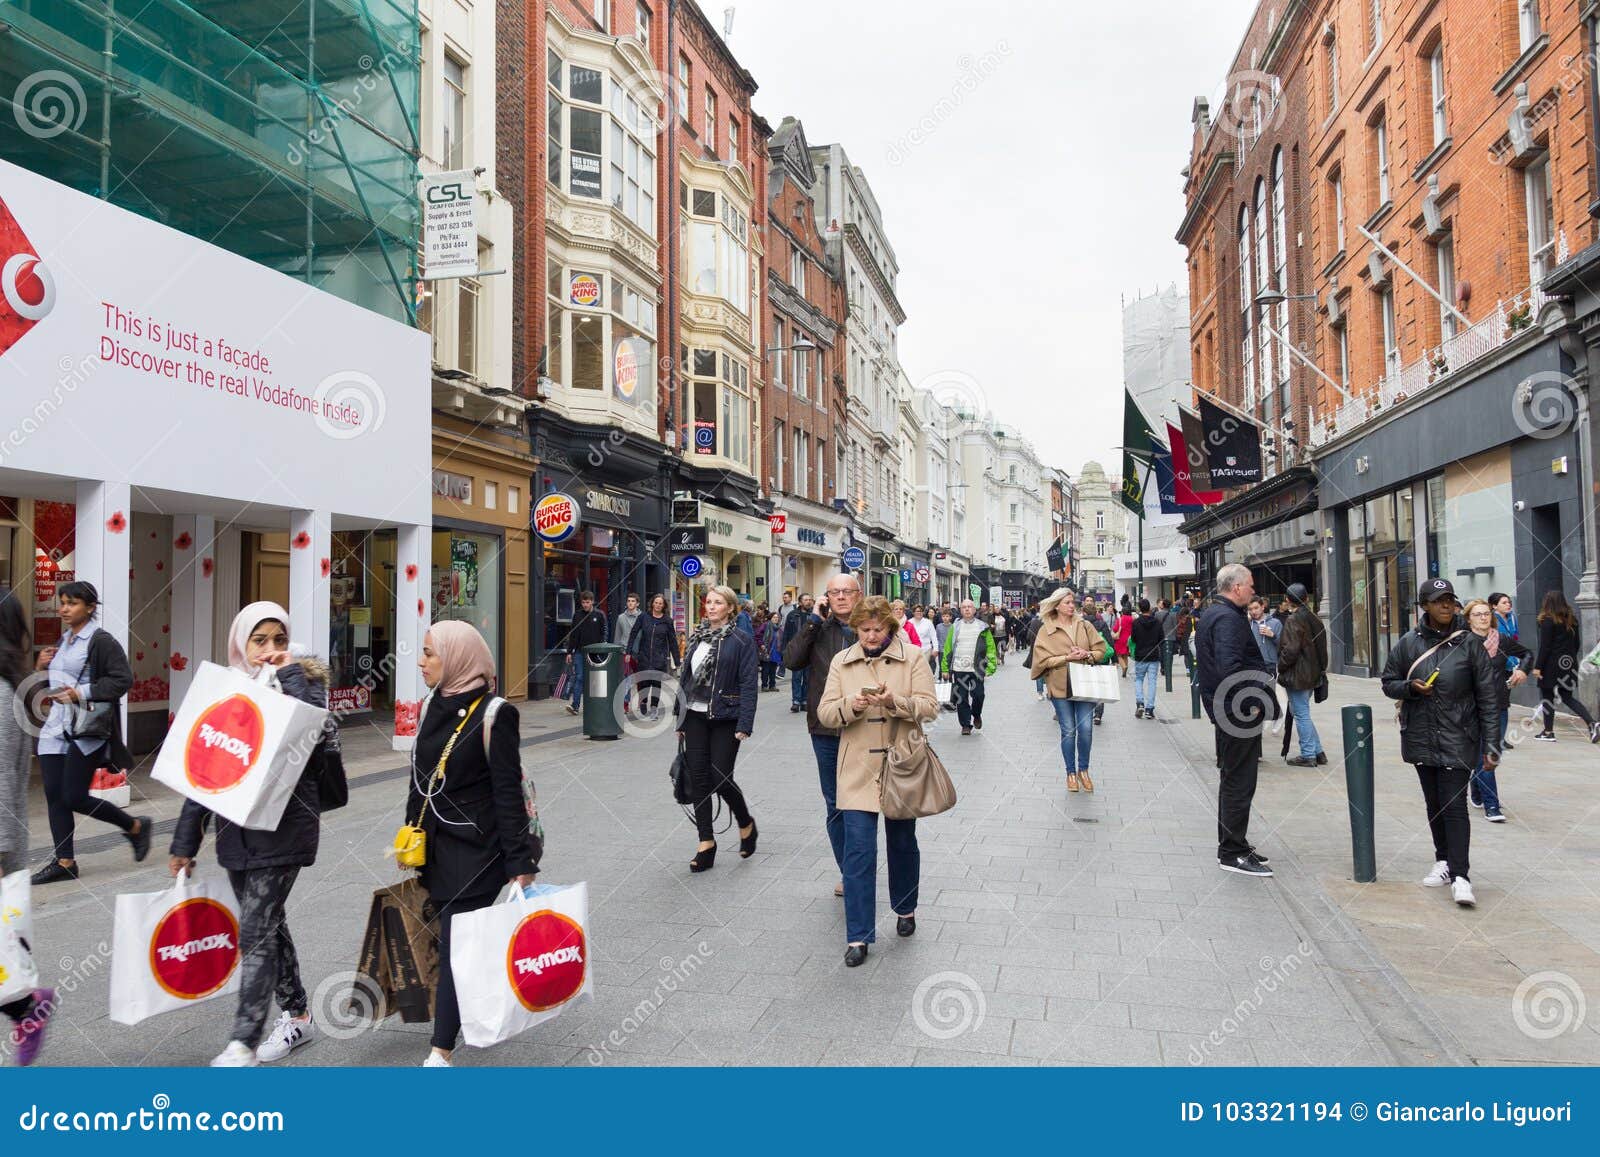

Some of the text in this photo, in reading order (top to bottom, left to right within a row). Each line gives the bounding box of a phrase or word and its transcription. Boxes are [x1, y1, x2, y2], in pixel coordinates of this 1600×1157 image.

[427, 183, 472, 204] CSL
[571, 282, 597, 290] BURGER
[572, 289, 597, 298] KING
[102, 302, 273, 375] This is just a façade.
[101, 335, 362, 426] Discover the real Vodafone inside.
[536, 501, 571, 520] BURGER
[586, 490, 630, 517] SWAROVSKI
[537, 510, 572, 532] KING
[705, 517, 733, 537] BUS STOP
[797, 527, 826, 546] OFFICE
[671, 543, 704, 551] SWAROVSKI
[1144, 559, 1167, 570] THOMAS
[333, 689, 355, 699] SEATS
